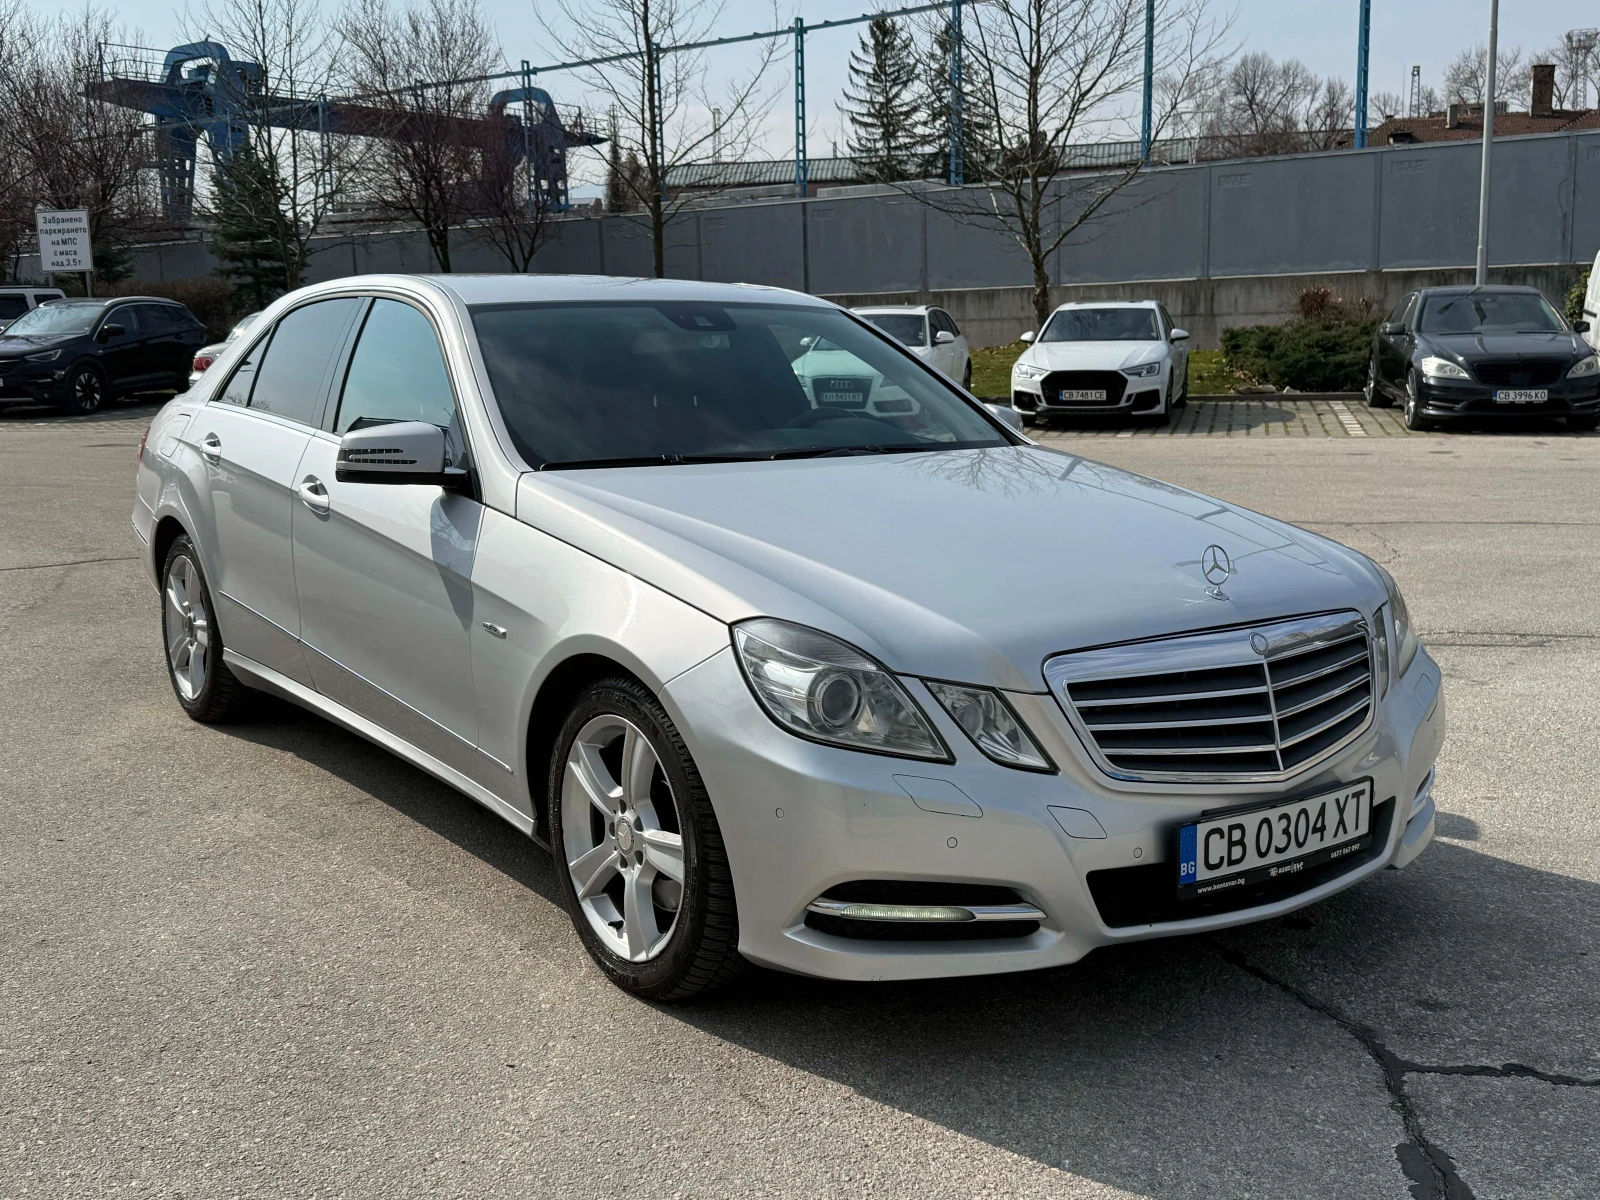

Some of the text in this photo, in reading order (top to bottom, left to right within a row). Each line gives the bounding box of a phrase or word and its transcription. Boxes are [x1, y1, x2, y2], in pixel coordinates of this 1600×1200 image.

[42, 216, 83, 225] Забранено
[40, 227, 87, 236] паркирането
[61, 237, 78, 246] МПС
[1063, 391, 1105, 399] CB 7481 CE
[1498, 391, 1510, 400] CB
[1511, 391, 1533, 400] 3996
[1203, 788, 1366, 871] CB 0304 XT
[1180, 861, 1195, 876] BG
[1197, 878, 1245, 894] www.kentavar.bg
